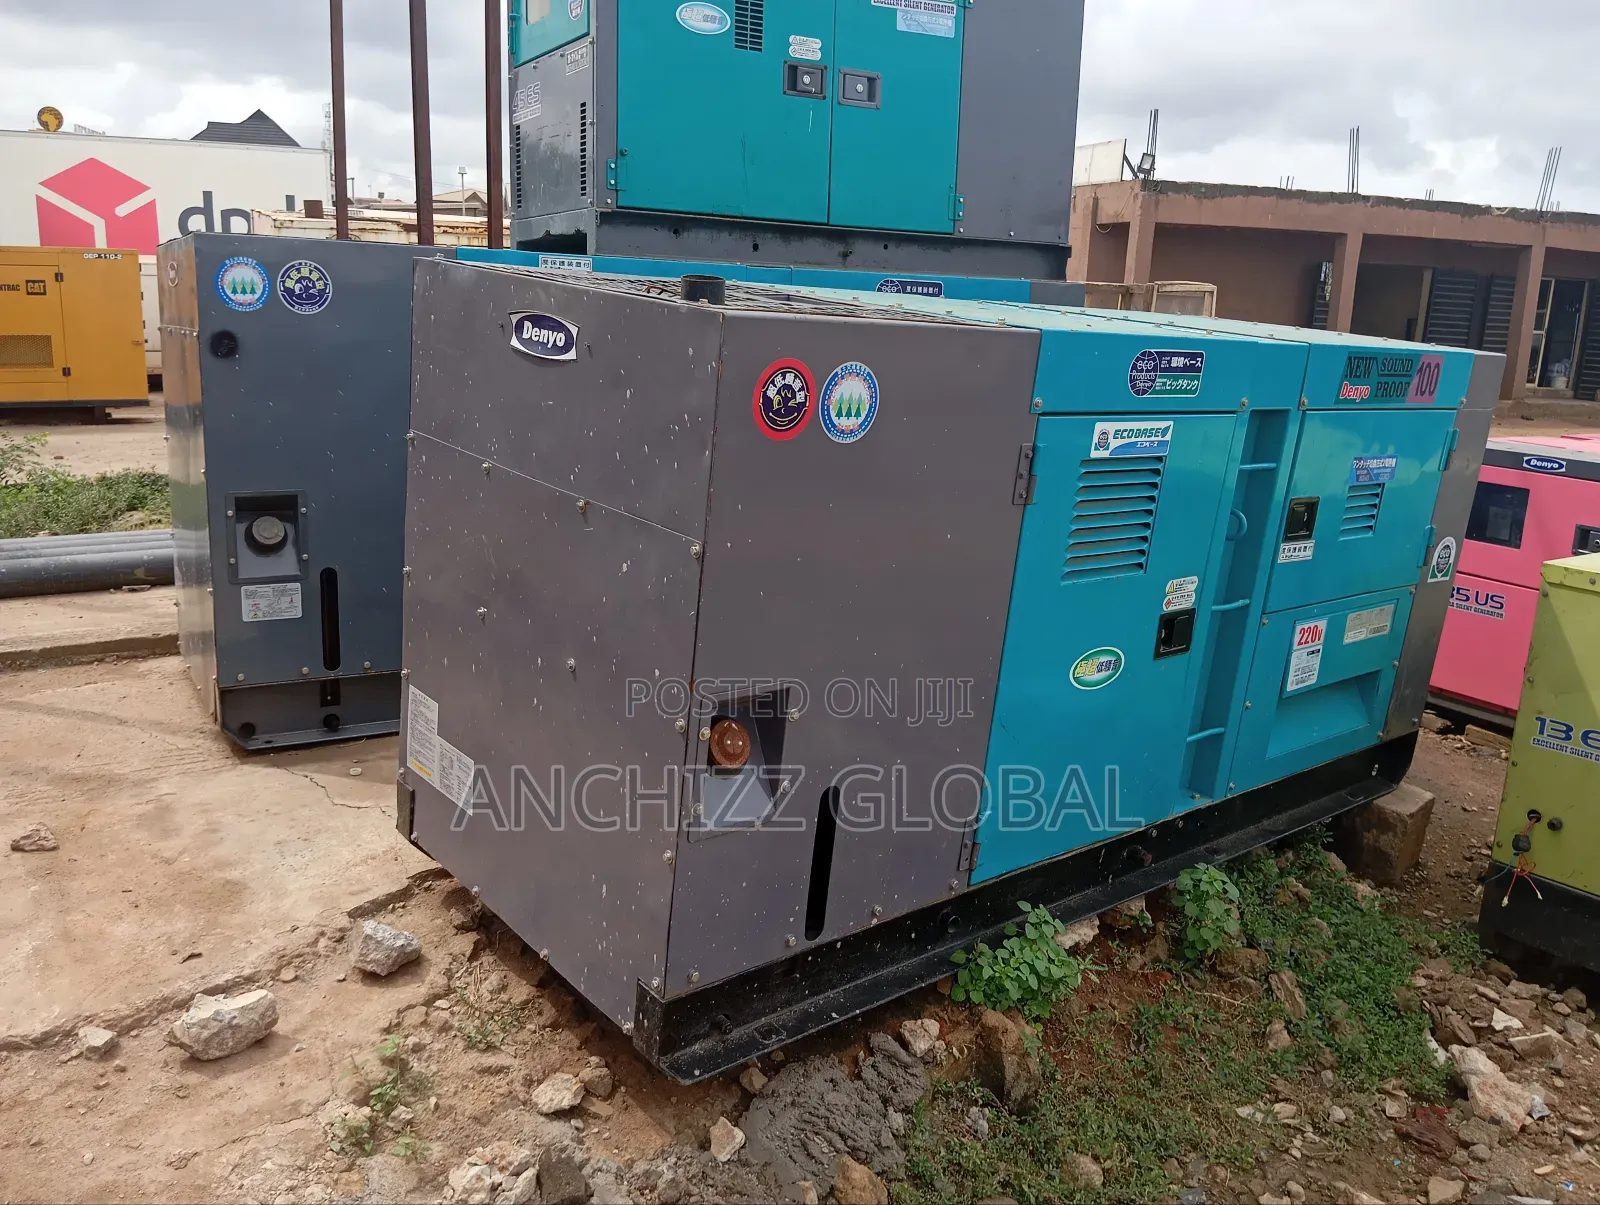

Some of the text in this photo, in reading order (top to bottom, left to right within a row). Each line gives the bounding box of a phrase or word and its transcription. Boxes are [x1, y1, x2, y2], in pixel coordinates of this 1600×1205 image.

[903, 0, 922, 10] SILENT
[923, 2, 955, 15] GENERATOR
[178, 190, 295, 237] dp
[27, 282, 45, 293] CAT
[522, 320, 566, 348] Denyo
[1137, 360, 1154, 370] eco
[1171, 357, 1202, 367] 環境ベース
[1344, 356, 1413, 378] NEW SOUND
[1132, 370, 1156, 380] Products
[1414, 362, 1440, 397] 100
[1166, 379, 1199, 390] ビッグタンク
[1340, 381, 1410, 402] Denyo PROOF
[1113, 427, 1162, 440] ECOBASE
[1530, 458, 1559, 468] Denyo
[1475, 590, 1505, 610] US
[1455, 602, 1473, 612] SILENT
[1473, 606, 1504, 619] GENERATOR
[1532, 737, 1569, 754] EXCELLENT
[1569, 747, 1594, 760] SILENT
